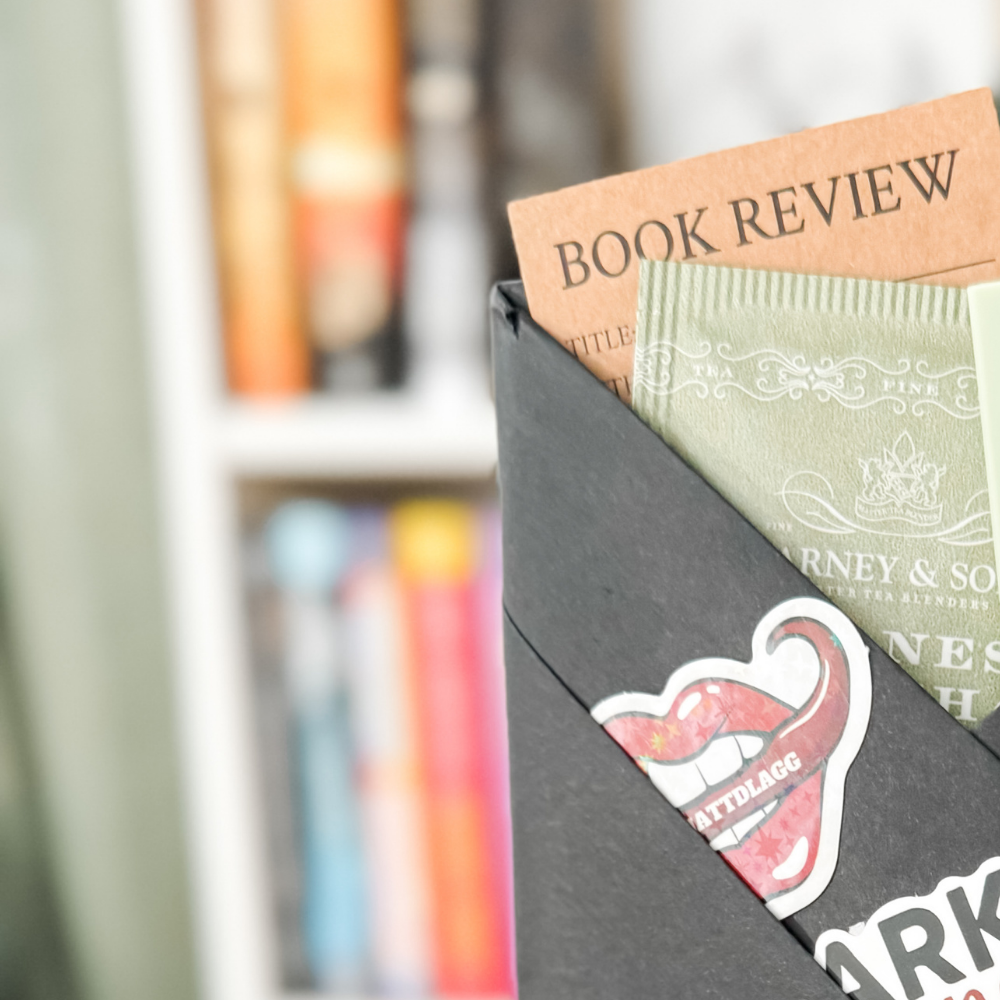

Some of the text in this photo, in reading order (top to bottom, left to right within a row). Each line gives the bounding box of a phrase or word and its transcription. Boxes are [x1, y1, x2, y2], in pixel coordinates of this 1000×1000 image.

[553, 148, 960, 290] BOOK REVIEW
[693, 364, 733, 378] TEA
[883, 379, 939, 396] FINE
[909, 558, 939, 588] &
[864, 590, 894, 602] TEA
[902, 592, 989, 611] BLENDERS
